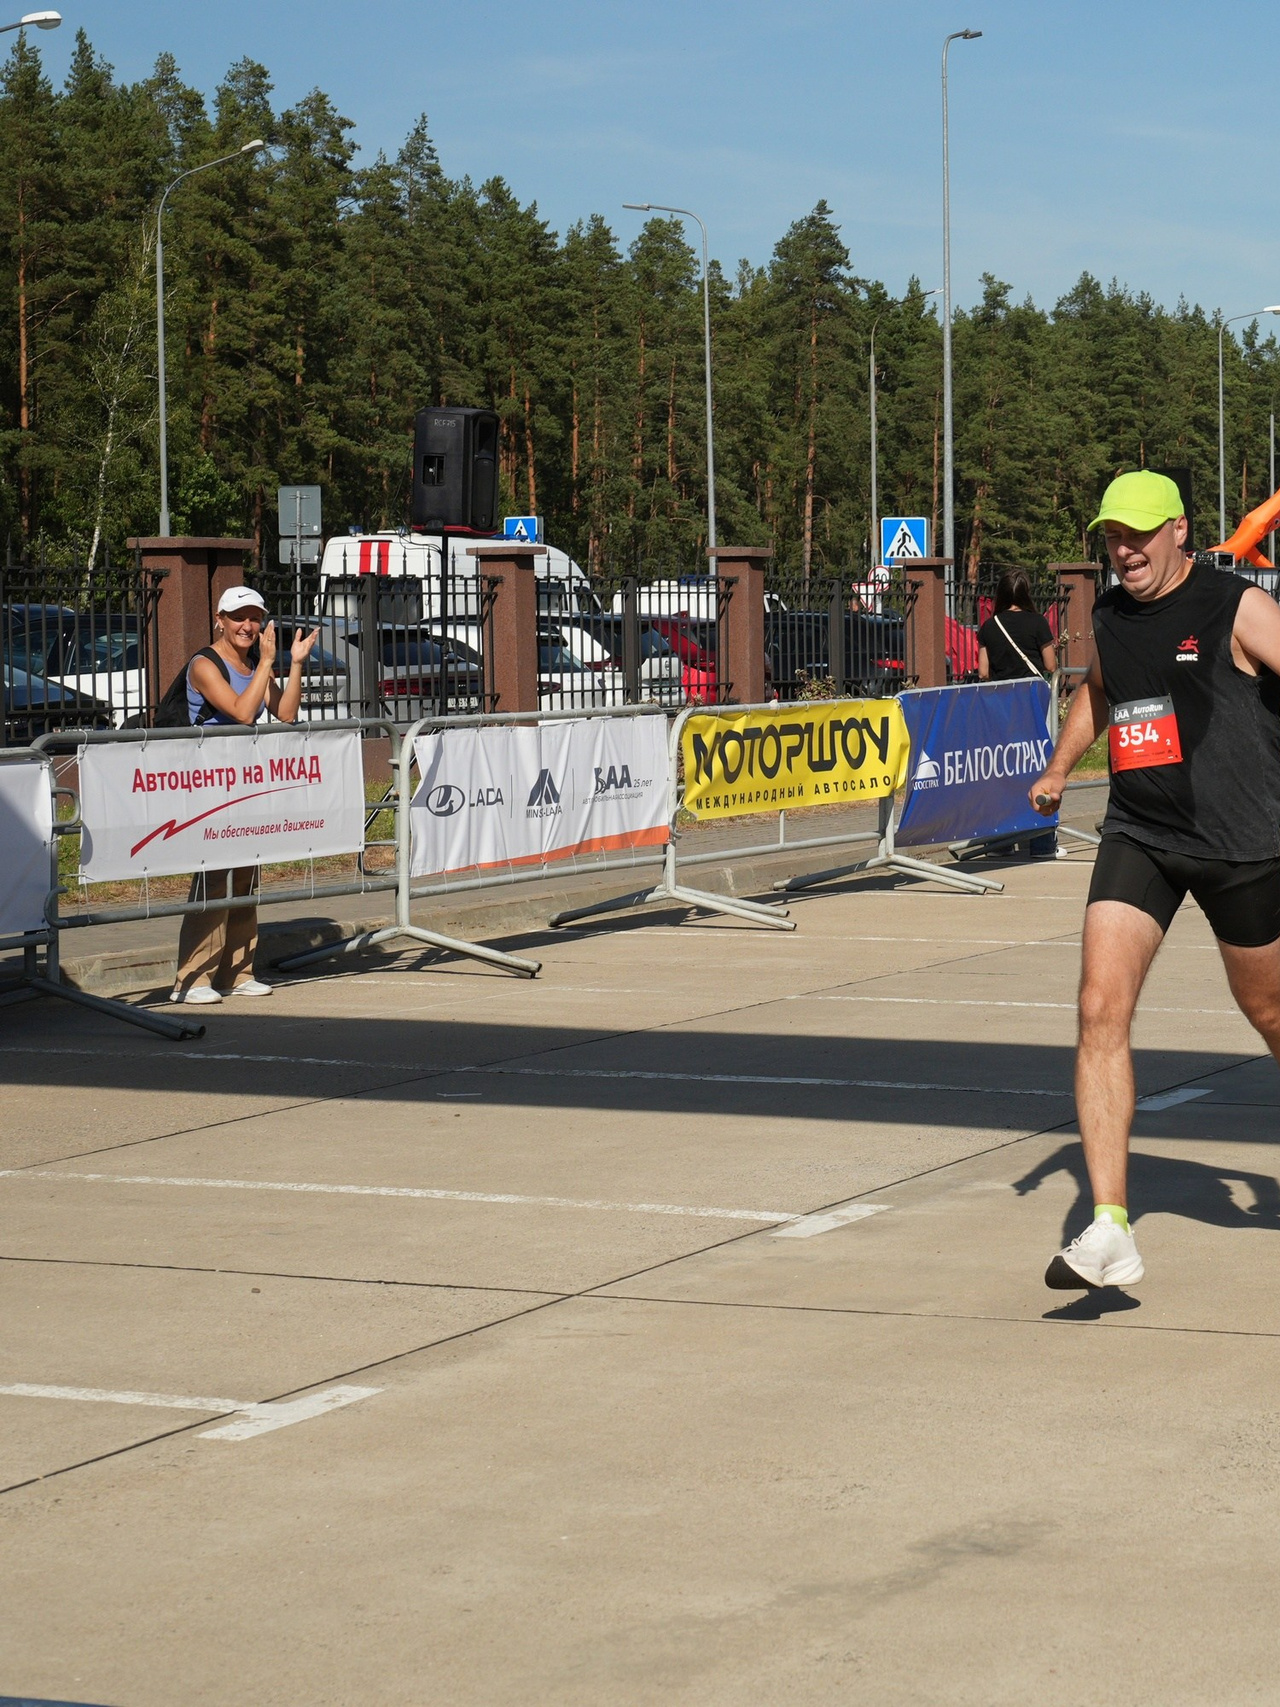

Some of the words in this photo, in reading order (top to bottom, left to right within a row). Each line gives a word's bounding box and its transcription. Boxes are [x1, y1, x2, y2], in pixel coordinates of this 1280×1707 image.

[1119, 723, 1159, 748] 354
[1165, 738, 1171, 746] 2
[692, 716, 889, 786] МОТОРШОУ
[944, 739, 1049, 786] БЕЛГОССТРАХ
[132, 767, 236, 793] Автоцентр
[243, 764, 263, 784] на
[269, 755, 322, 783] МКАД
[641, 779, 652, 787] лет
[470, 788, 504, 807] LADA
[696, 783, 804, 810] МЕЖДУНАРОДНЫЙ
[203, 827, 219, 841] Мы
[220, 822, 282, 839] обеспечиваем
[283, 819, 325, 832] движение
